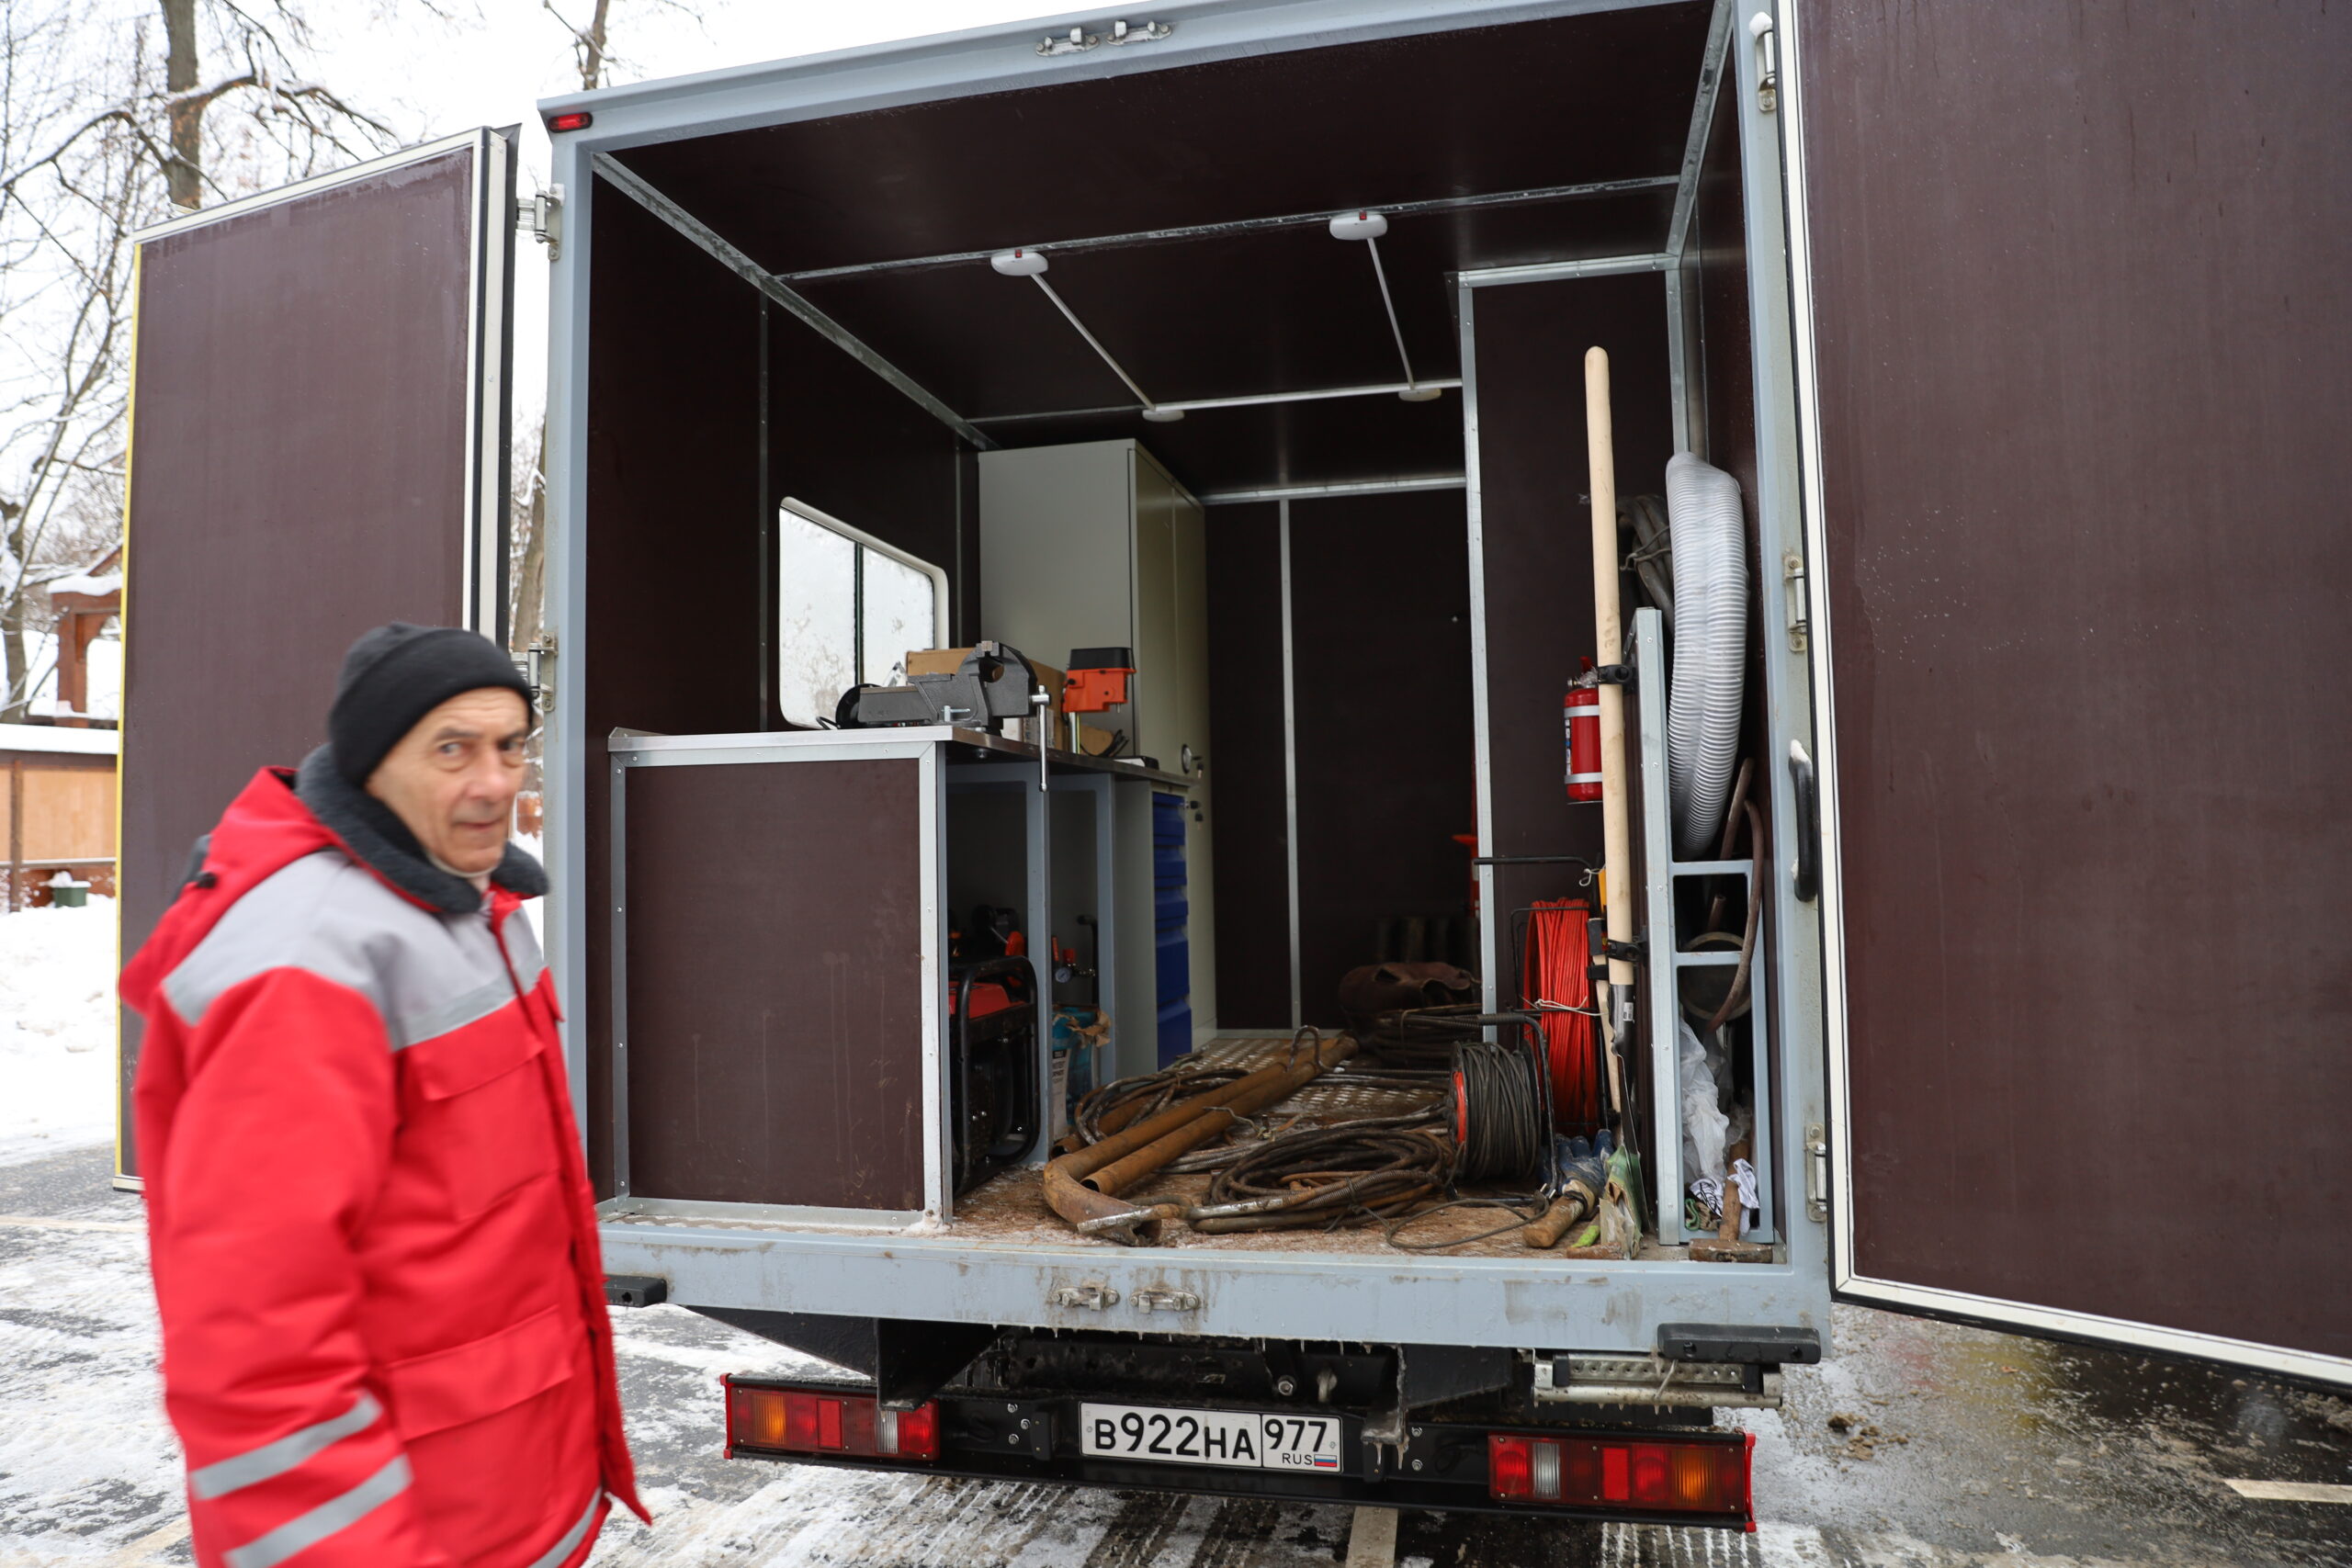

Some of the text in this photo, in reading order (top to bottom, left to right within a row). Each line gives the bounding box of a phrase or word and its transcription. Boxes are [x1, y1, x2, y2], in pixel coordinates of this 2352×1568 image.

[1094, 1412, 1329, 1461] В922НА 977
[1282, 1452, 1314, 1466] RUS
